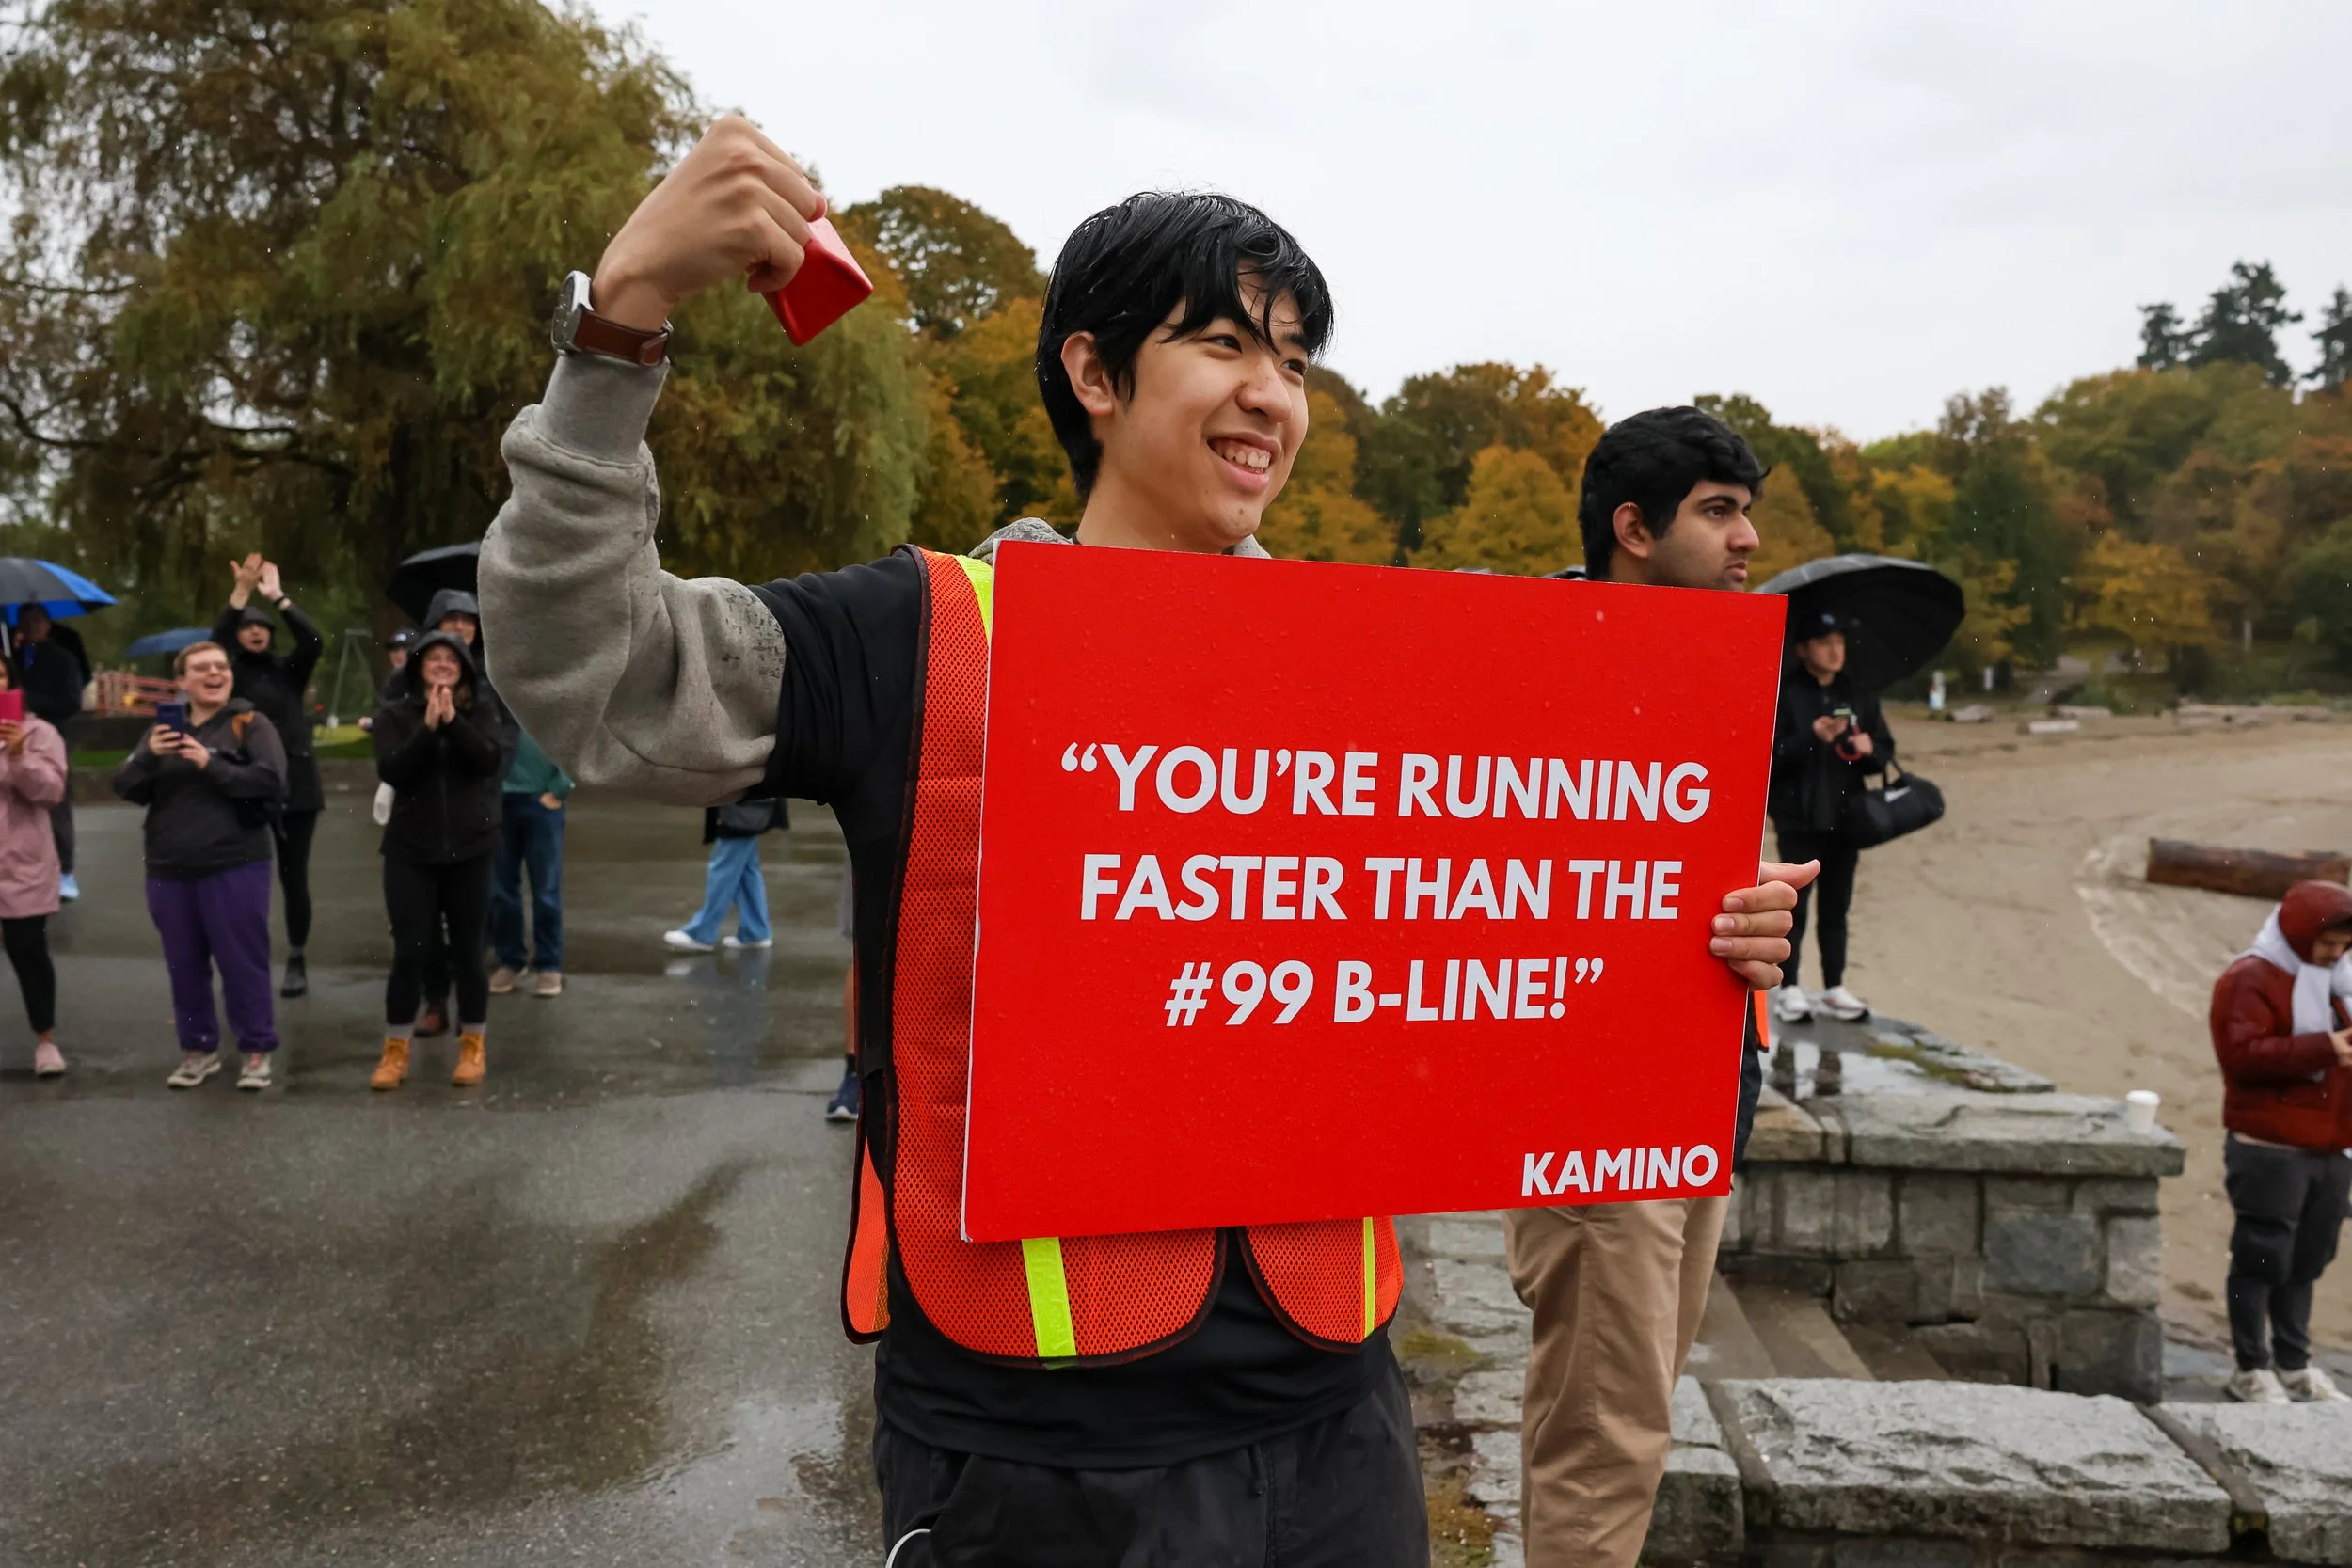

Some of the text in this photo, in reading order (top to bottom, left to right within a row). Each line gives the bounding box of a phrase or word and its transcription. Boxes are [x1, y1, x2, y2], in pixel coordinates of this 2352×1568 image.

[1398, 753, 1711, 823] RUNNING
[1080, 853, 1683, 921] FASTER THAN THE
[1164, 959, 1314, 1027] #99
[1521, 1144, 1719, 1196] KAMINO
